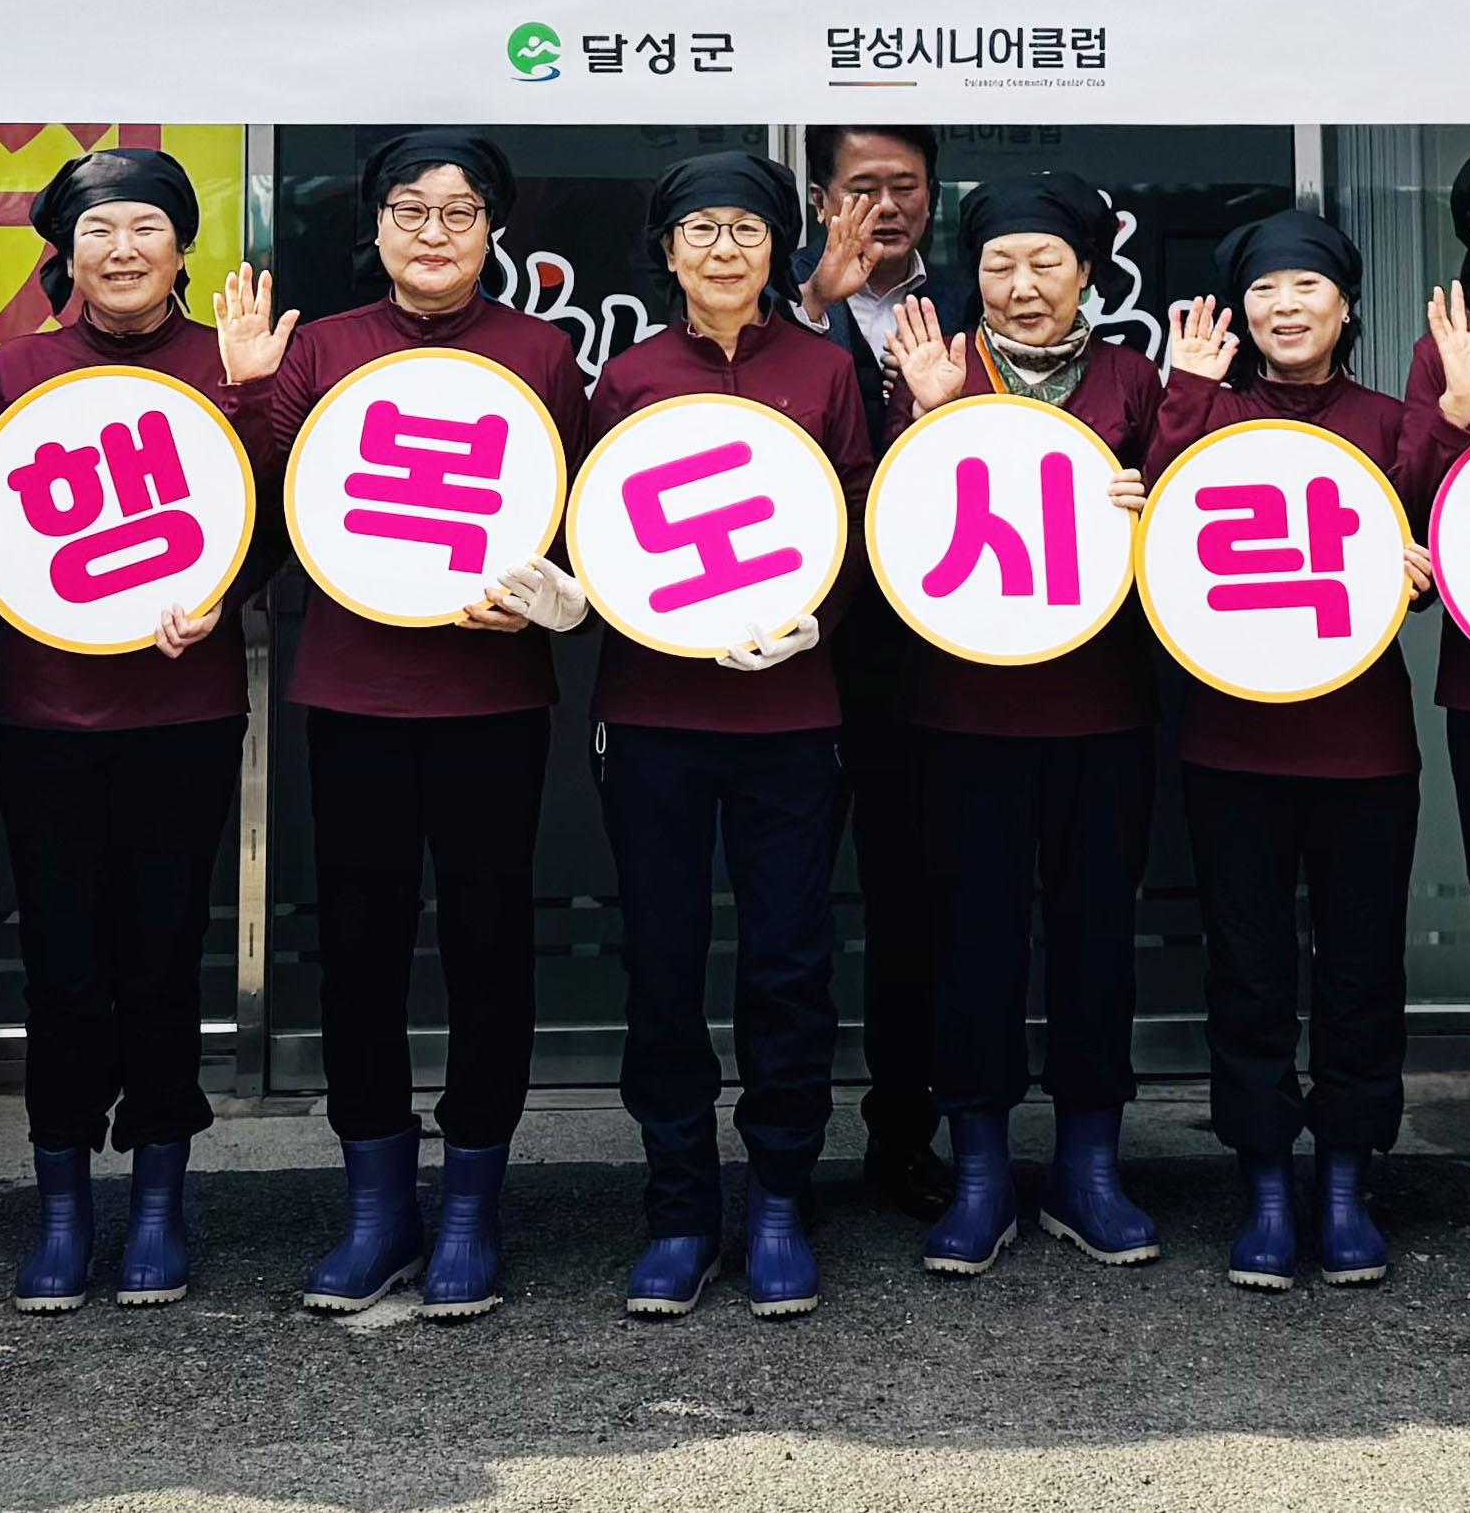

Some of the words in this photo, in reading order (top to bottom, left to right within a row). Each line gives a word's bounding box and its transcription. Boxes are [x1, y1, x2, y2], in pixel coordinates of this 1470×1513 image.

[582, 33, 735, 75] 달성군
[828, 27, 1107, 70] 달성시니어클럽
[7, 410, 204, 603] 행
[344, 400, 509, 574] 복
[622, 440, 802, 613] 도
[922, 451, 1080, 606] 시
[1195, 476, 1360, 639] 락
